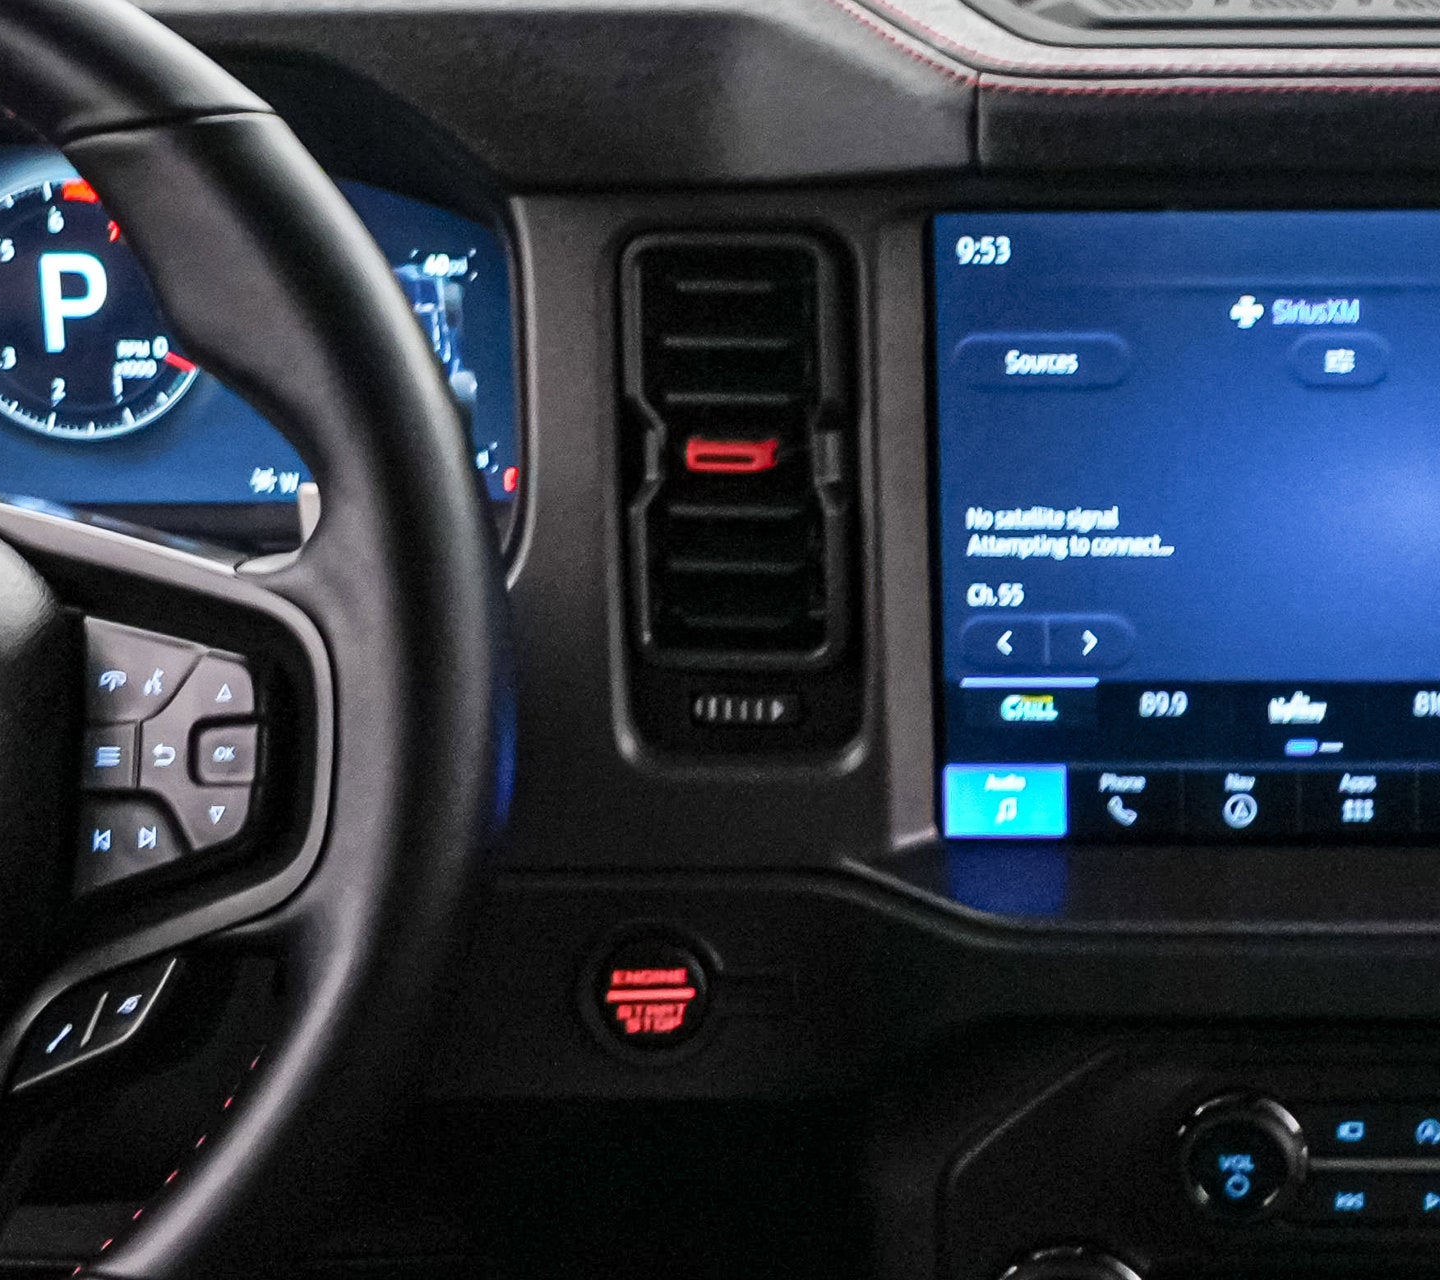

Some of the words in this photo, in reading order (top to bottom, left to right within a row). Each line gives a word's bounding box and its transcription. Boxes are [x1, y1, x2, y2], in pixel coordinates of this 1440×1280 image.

[47, 205, 65, 234] 6
[956, 235, 1011, 265] 9:53
[38, 251, 108, 354] P
[1272, 297, 1360, 325] SiriusXM
[151, 335, 169, 360] 0
[1004, 349, 1078, 375] Sources
[50, 377, 67, 407] 2
[965, 506, 994, 531] No
[994, 506, 1066, 531] satellite
[1066, 505, 1120, 534] signal
[965, 533, 1068, 561] Attempting
[1069, 534, 1091, 557] to
[997, 582, 1025, 608] 55
[212, 746, 236, 763] OK
[1098, 772, 1147, 794] Phone
[1218, 1153, 1256, 1173] VOL
